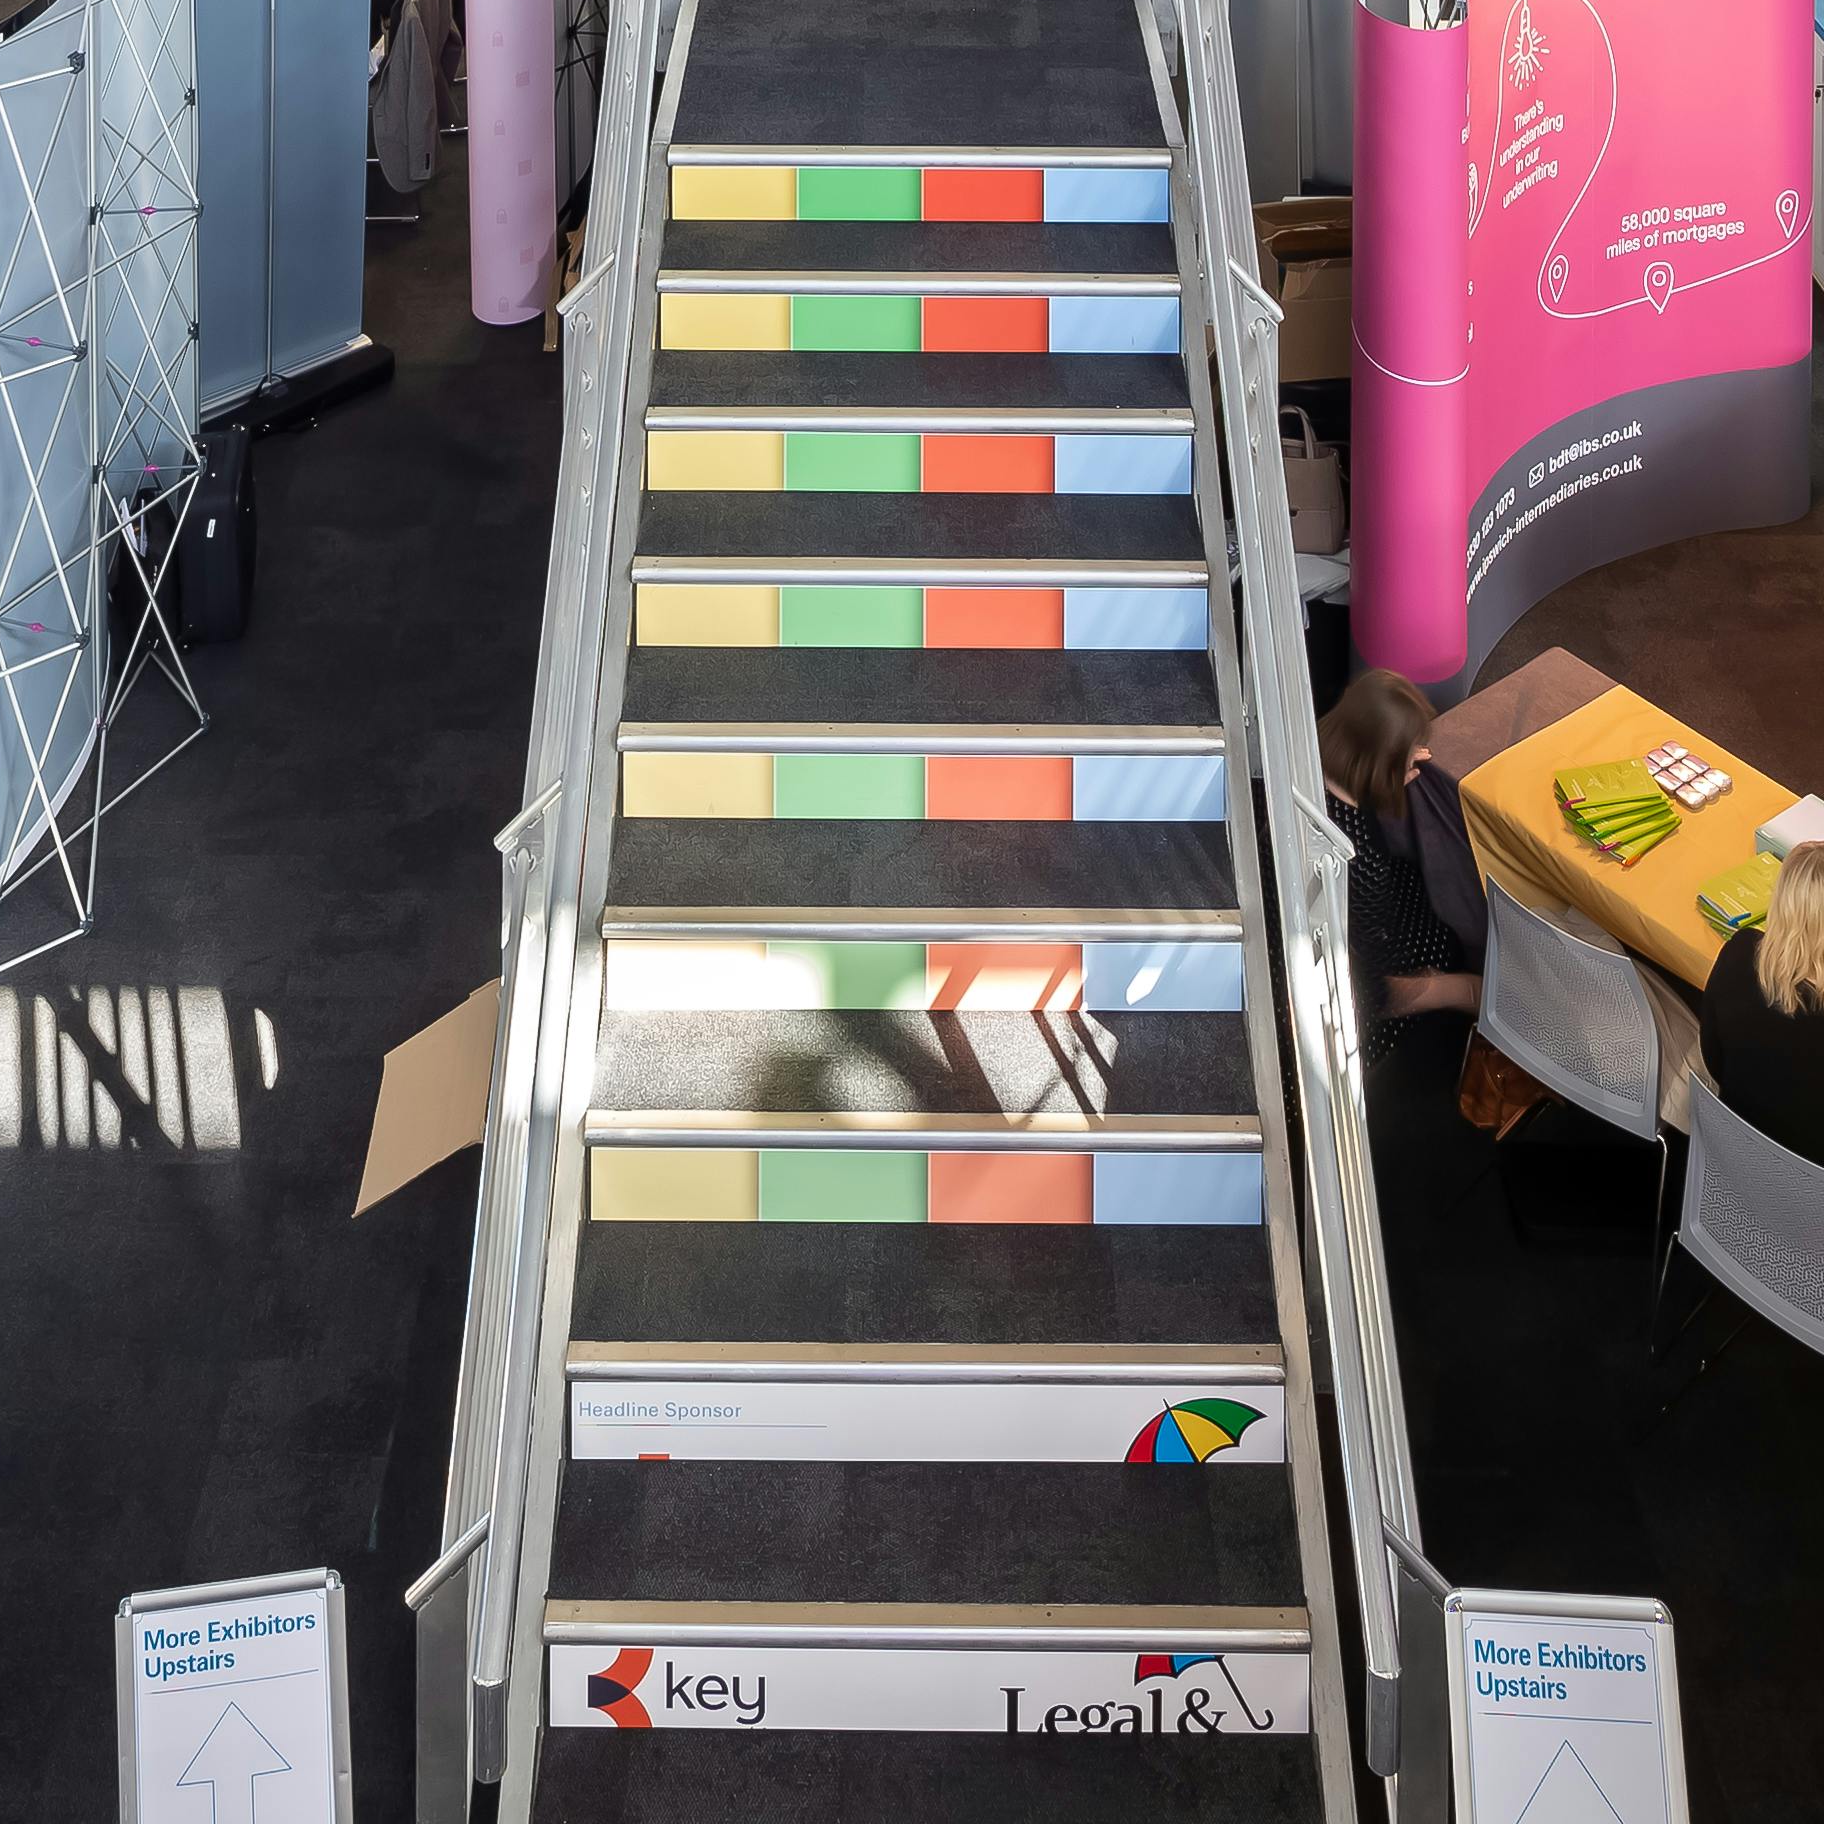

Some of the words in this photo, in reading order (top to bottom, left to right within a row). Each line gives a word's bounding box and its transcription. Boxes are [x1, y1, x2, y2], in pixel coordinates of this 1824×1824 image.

[1500, 114, 1563, 167] understanding
[1503, 160, 1557, 208] underwriting
[1620, 206, 1670, 233] 58,000
[1674, 200, 1726, 223] square
[1606, 233, 1641, 260] miles
[1644, 229, 1660, 247] of
[1662, 219, 1745, 247] mortgages
[578, 1401, 659, 1418] Headline
[665, 1402, 742, 1422] Sponsor
[144, 1629, 201, 1651] More
[208, 1613, 316, 1643] Exhibitors
[145, 1650, 235, 1681] Upstairs
[1475, 1639, 1531, 1666] More
[1538, 1642, 1647, 1672] Exhibitors
[665, 1660, 767, 1724] key
[1477, 1671, 1567, 1702] Upstairs
